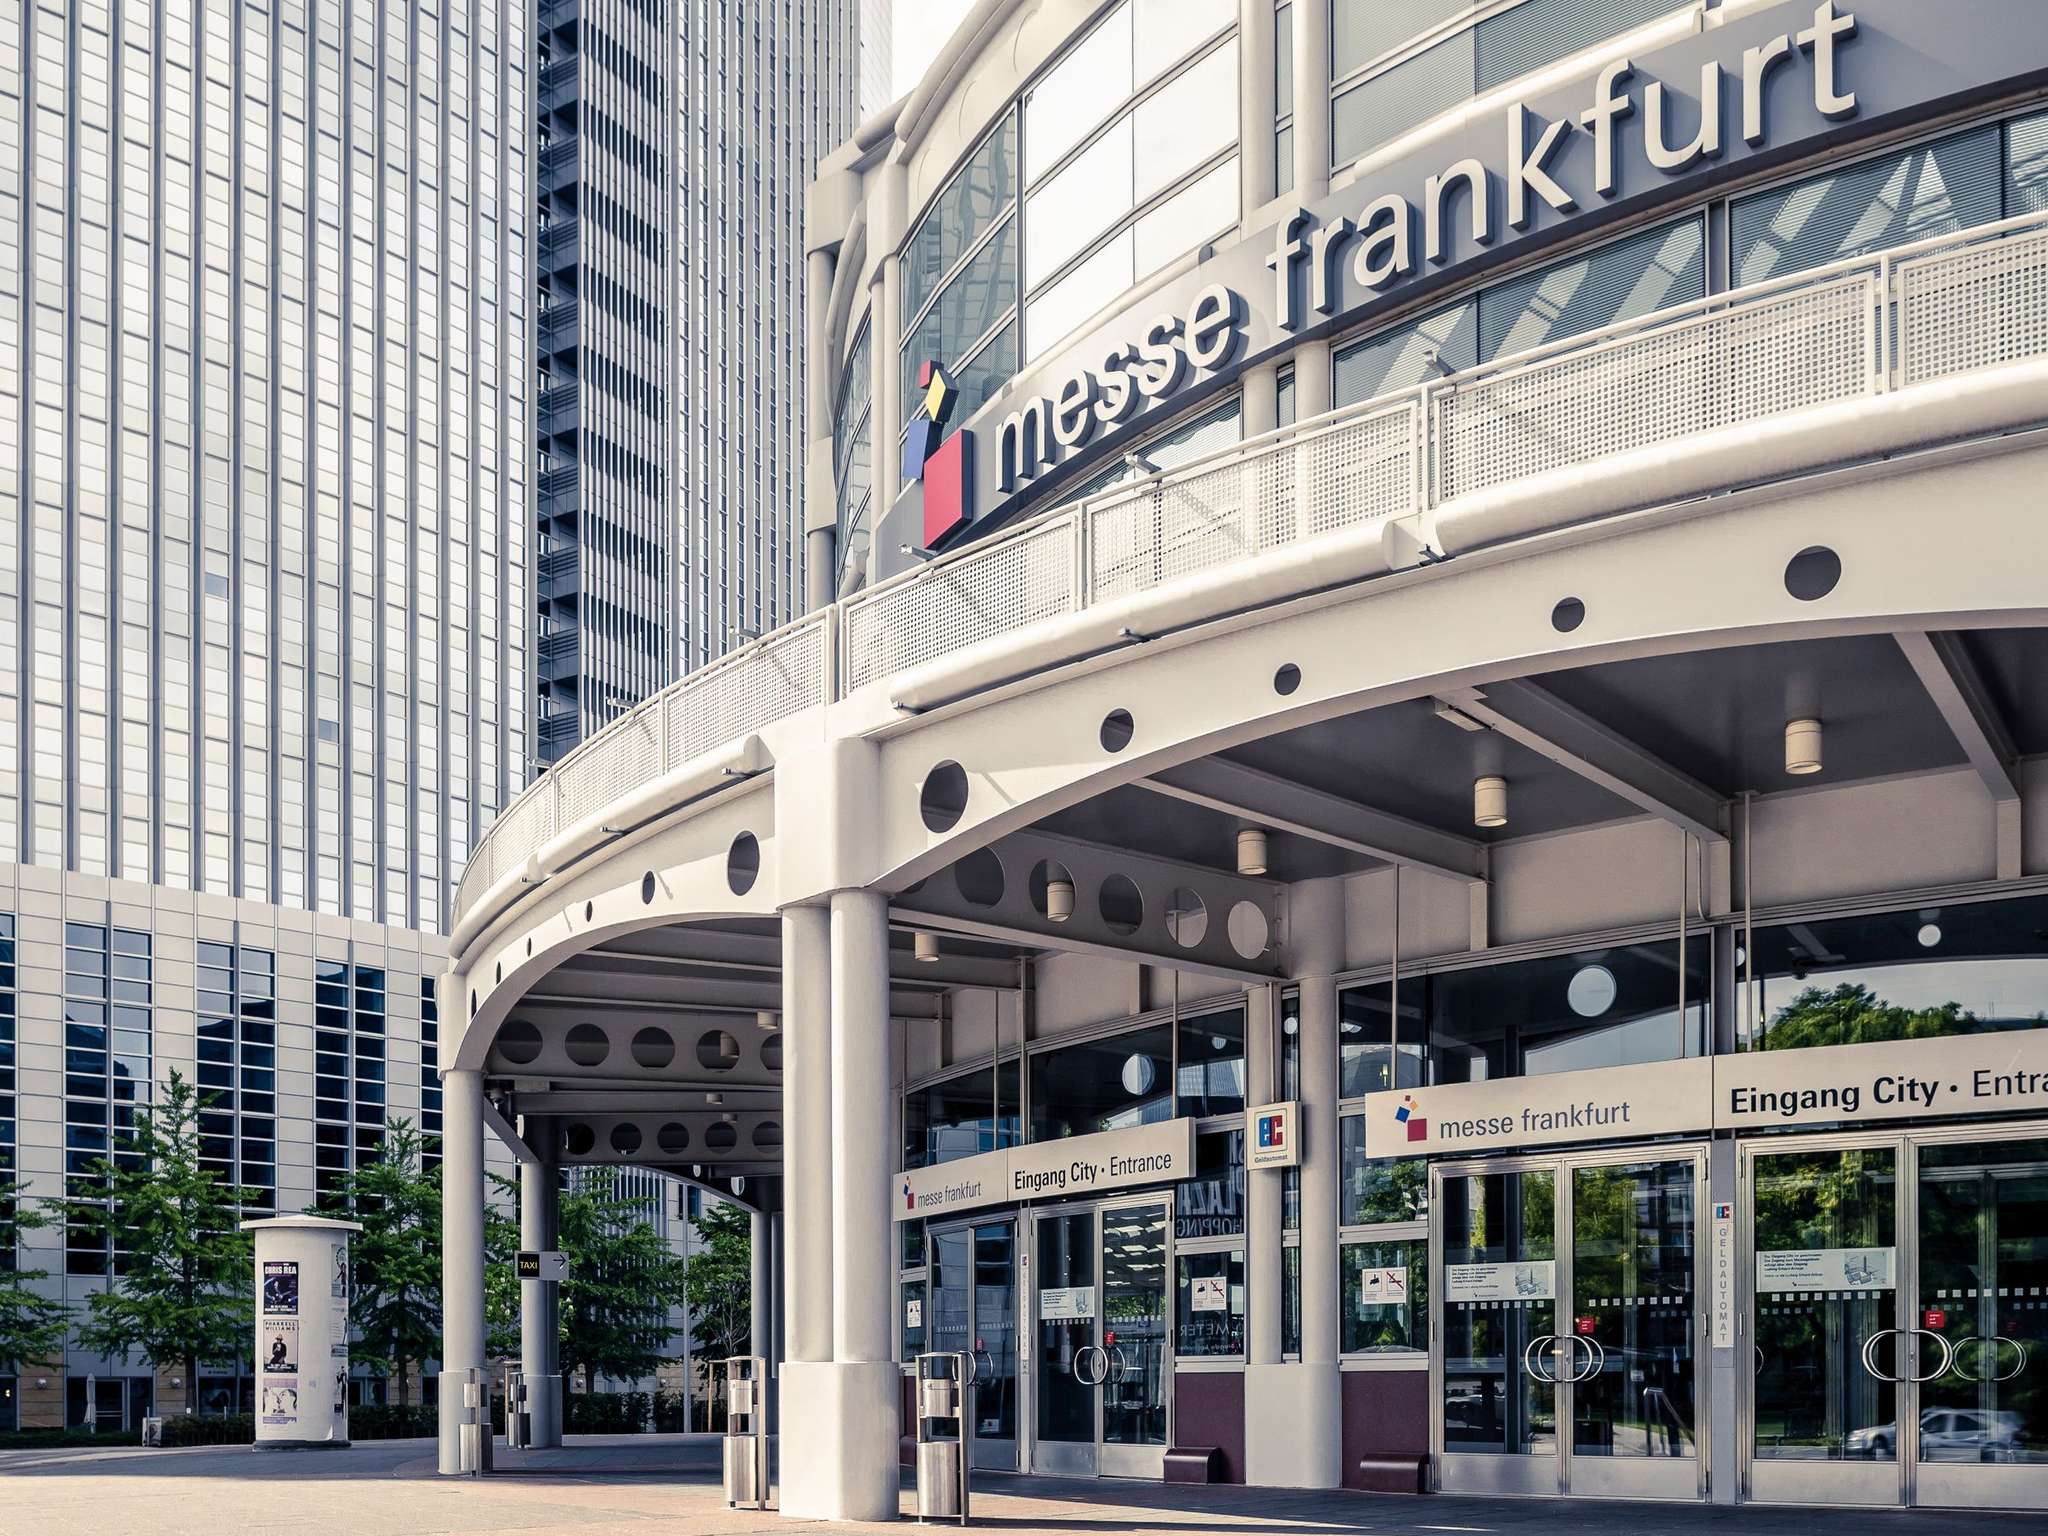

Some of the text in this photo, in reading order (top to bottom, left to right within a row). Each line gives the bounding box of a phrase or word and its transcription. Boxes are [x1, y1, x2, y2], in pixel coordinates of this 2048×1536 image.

[995, 0, 1859, 493] messe frankfurt
[1731, 1087, 1859, 1117] Eingang
[1873, 1077, 1939, 1107] City
[1440, 1101, 1631, 1139] messe frankfurt
[1015, 1168, 1066, 1191] Eingang
[1071, 1161, 1097, 1183] City
[1110, 1152, 1172, 1177] Entrance
[1255, 1154, 1288, 1163] Geldautomat
[918, 1181, 981, 1208] messe frankfurt
[520, 1261, 538, 1270] TAXI
[1719, 1228, 1728, 1341] GELDAUTOMAT
